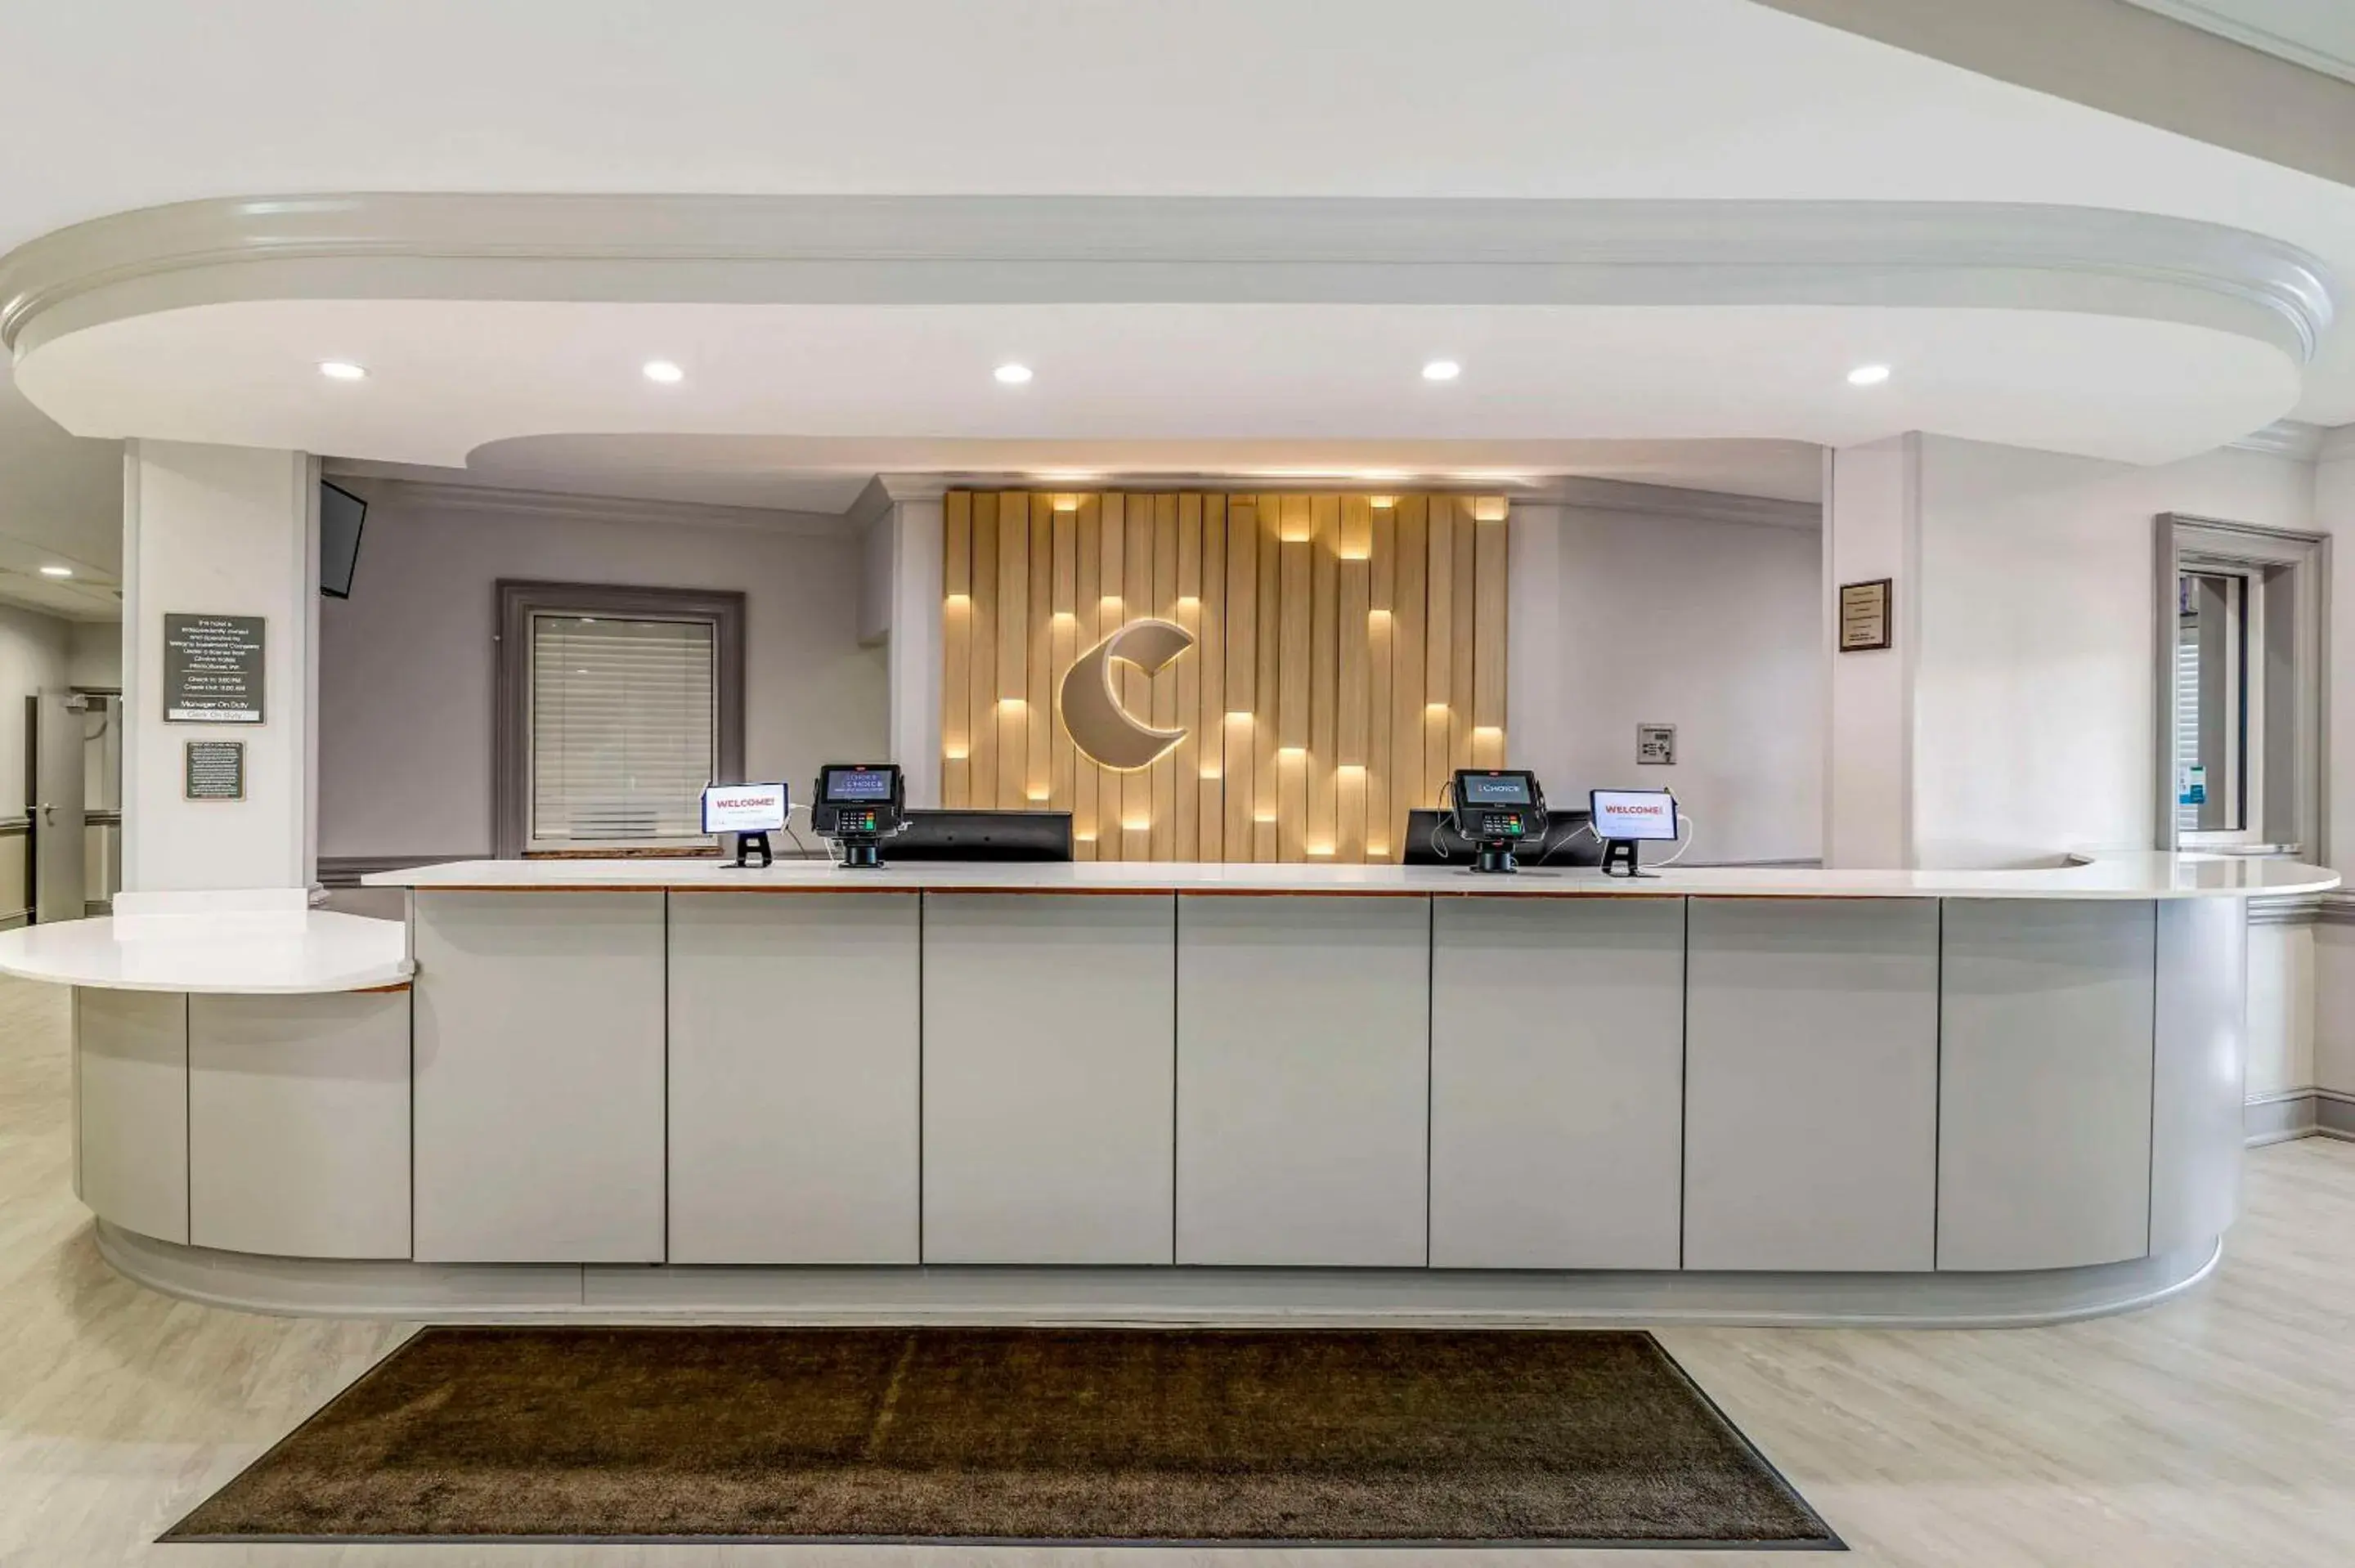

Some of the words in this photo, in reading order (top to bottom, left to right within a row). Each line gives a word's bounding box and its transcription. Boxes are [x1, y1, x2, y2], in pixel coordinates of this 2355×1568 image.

[181, 700, 217, 709] Manager
[716, 797, 775, 809] WELCOME!
[1605, 804, 1663, 814] WELCOME!
